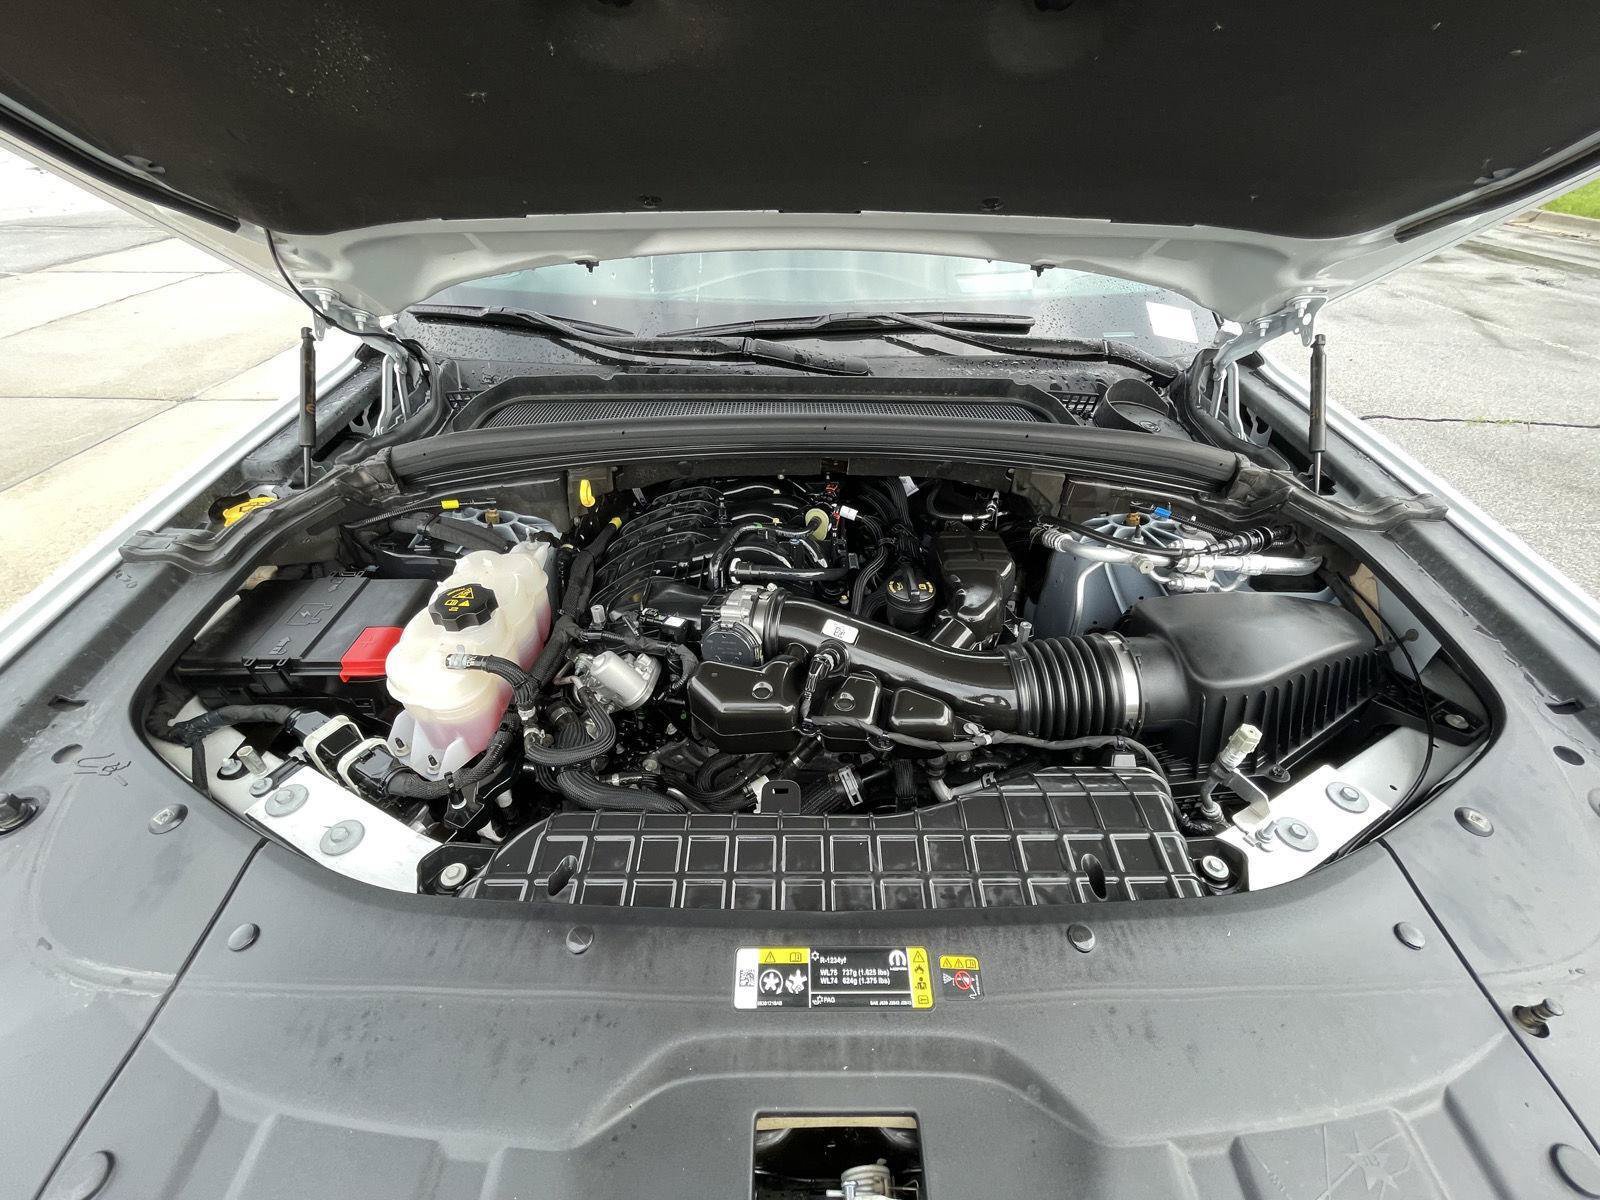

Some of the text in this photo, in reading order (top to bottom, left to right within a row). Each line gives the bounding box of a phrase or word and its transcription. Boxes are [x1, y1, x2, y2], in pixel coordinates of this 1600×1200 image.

[820, 956, 847, 965] R-1234yf
[820, 968, 838, 976] WL75
[842, 968, 857, 977] 737g
[877, 968, 890, 977] lbs)
[820, 977, 838, 985] WL74
[842, 977, 858, 986] 624g
[878, 977, 891, 986] lbs)
[823, 996, 836, 1004] PAG
